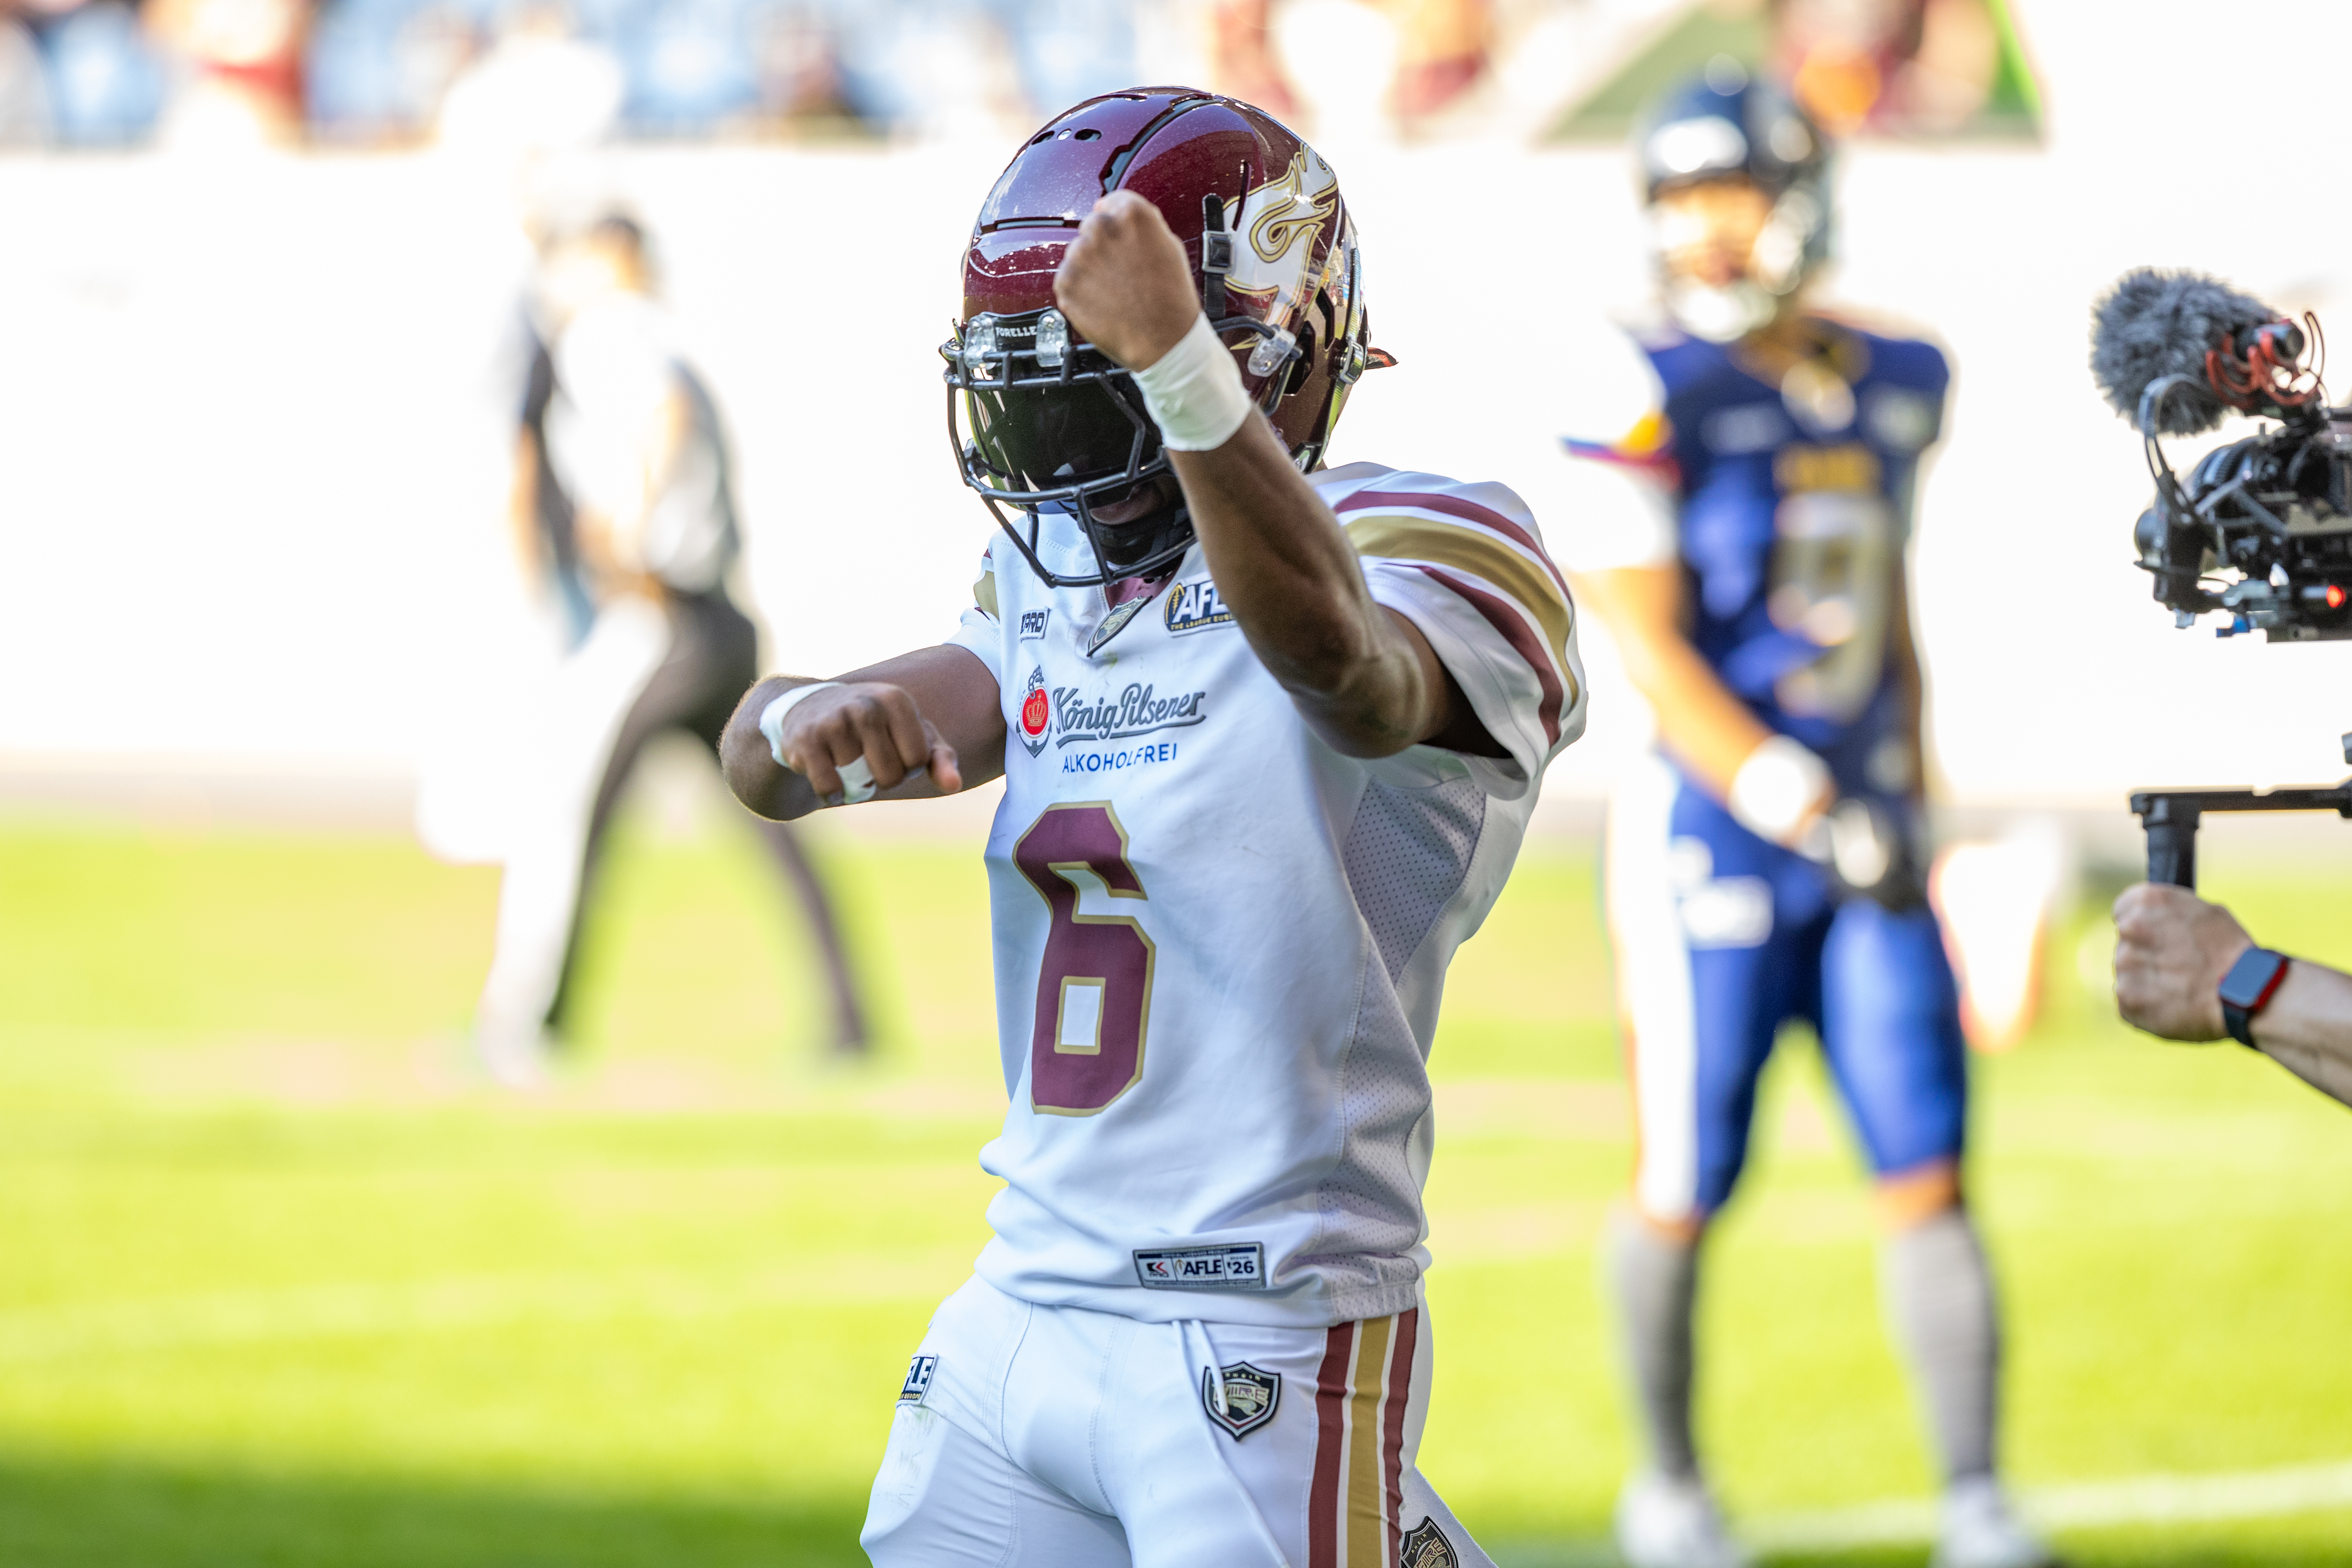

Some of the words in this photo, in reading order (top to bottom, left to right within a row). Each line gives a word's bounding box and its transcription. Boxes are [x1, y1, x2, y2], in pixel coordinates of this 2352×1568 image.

[1172, 581, 1229, 624] AFL
[1171, 622, 1184, 631] THE
[1053, 687, 1118, 739] König
[1114, 683, 1206, 729] Pilsener
[1062, 743, 1177, 773] ALKOHOLFREI
[1012, 800, 1156, 1117] 6
[1183, 1259, 1222, 1275] AFLE
[1227, 1261, 1254, 1274] '26
[902, 1357, 934, 1392] FLE
[1411, 1534, 1427, 1554] RHEIN
